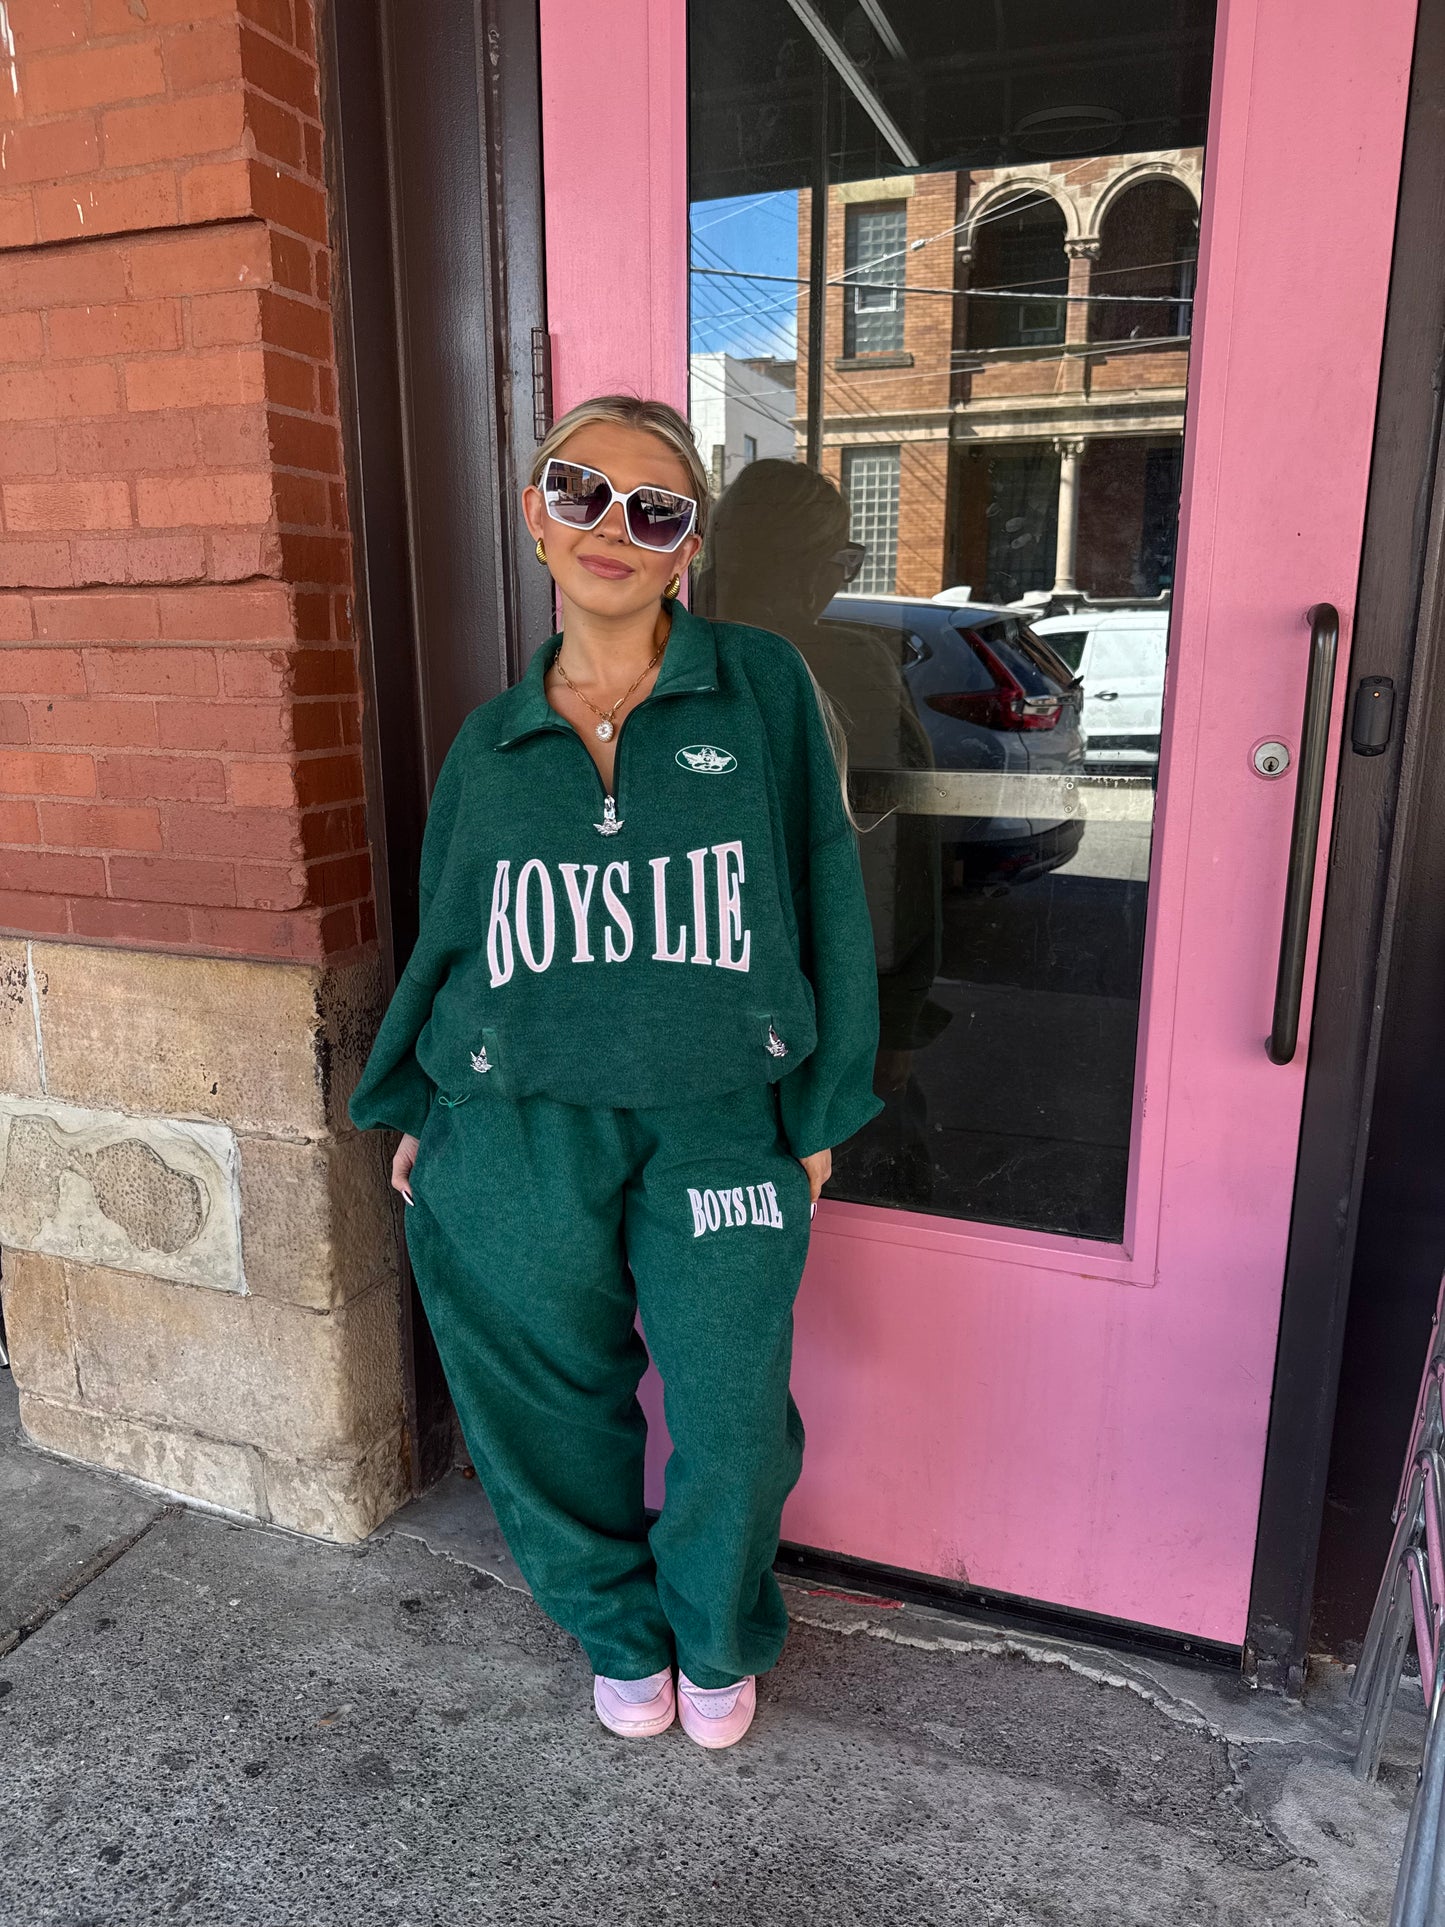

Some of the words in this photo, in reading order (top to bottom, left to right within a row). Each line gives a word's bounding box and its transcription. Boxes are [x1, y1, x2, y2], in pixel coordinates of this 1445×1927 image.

[487, 859, 633, 988] BOYS
[649, 841, 750, 972] LIE
[687, 1187, 746, 1237] BOYS
[746, 1182, 783, 1229] LIE
